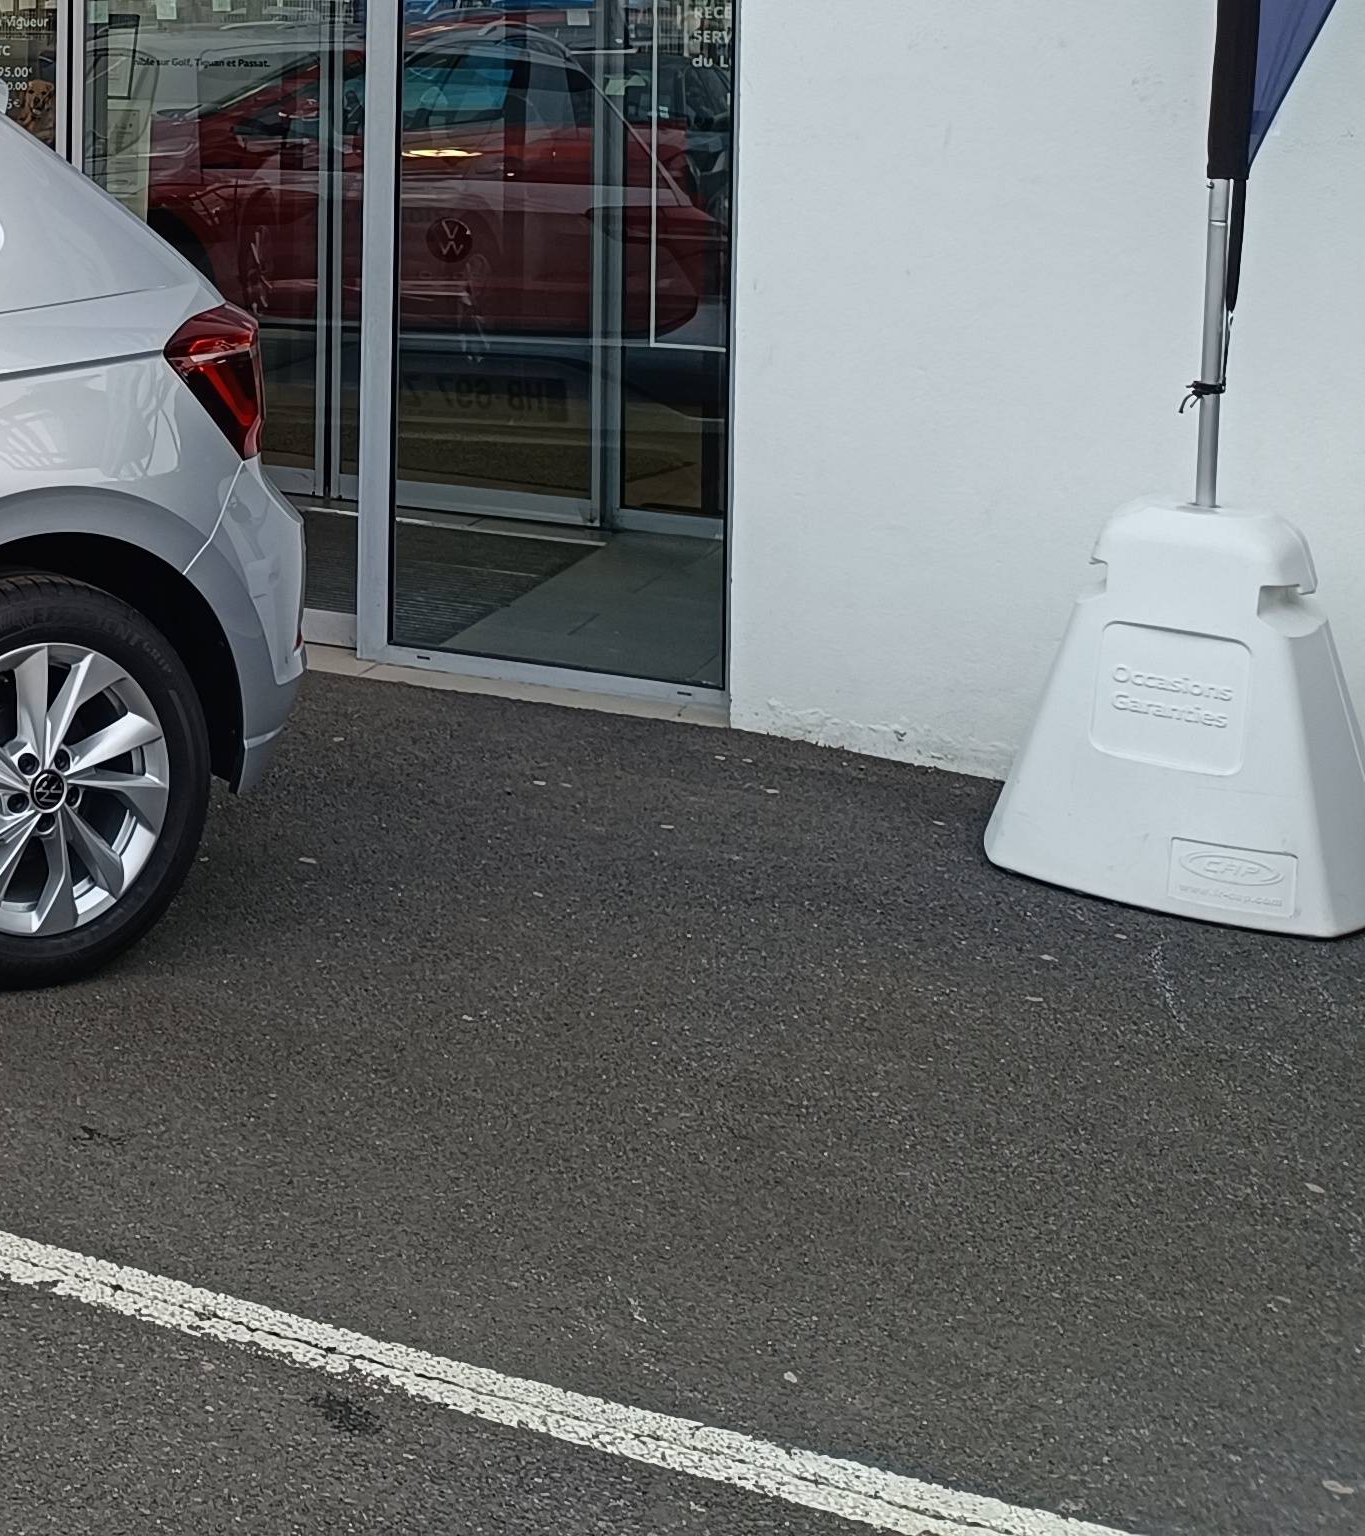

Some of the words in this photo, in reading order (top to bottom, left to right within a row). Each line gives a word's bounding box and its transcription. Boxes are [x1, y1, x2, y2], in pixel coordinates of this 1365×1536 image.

[7, 16, 49, 30] vigueur
[1112, 665, 1233, 702] Occasions
[1111, 692, 1229, 729] Garanties
